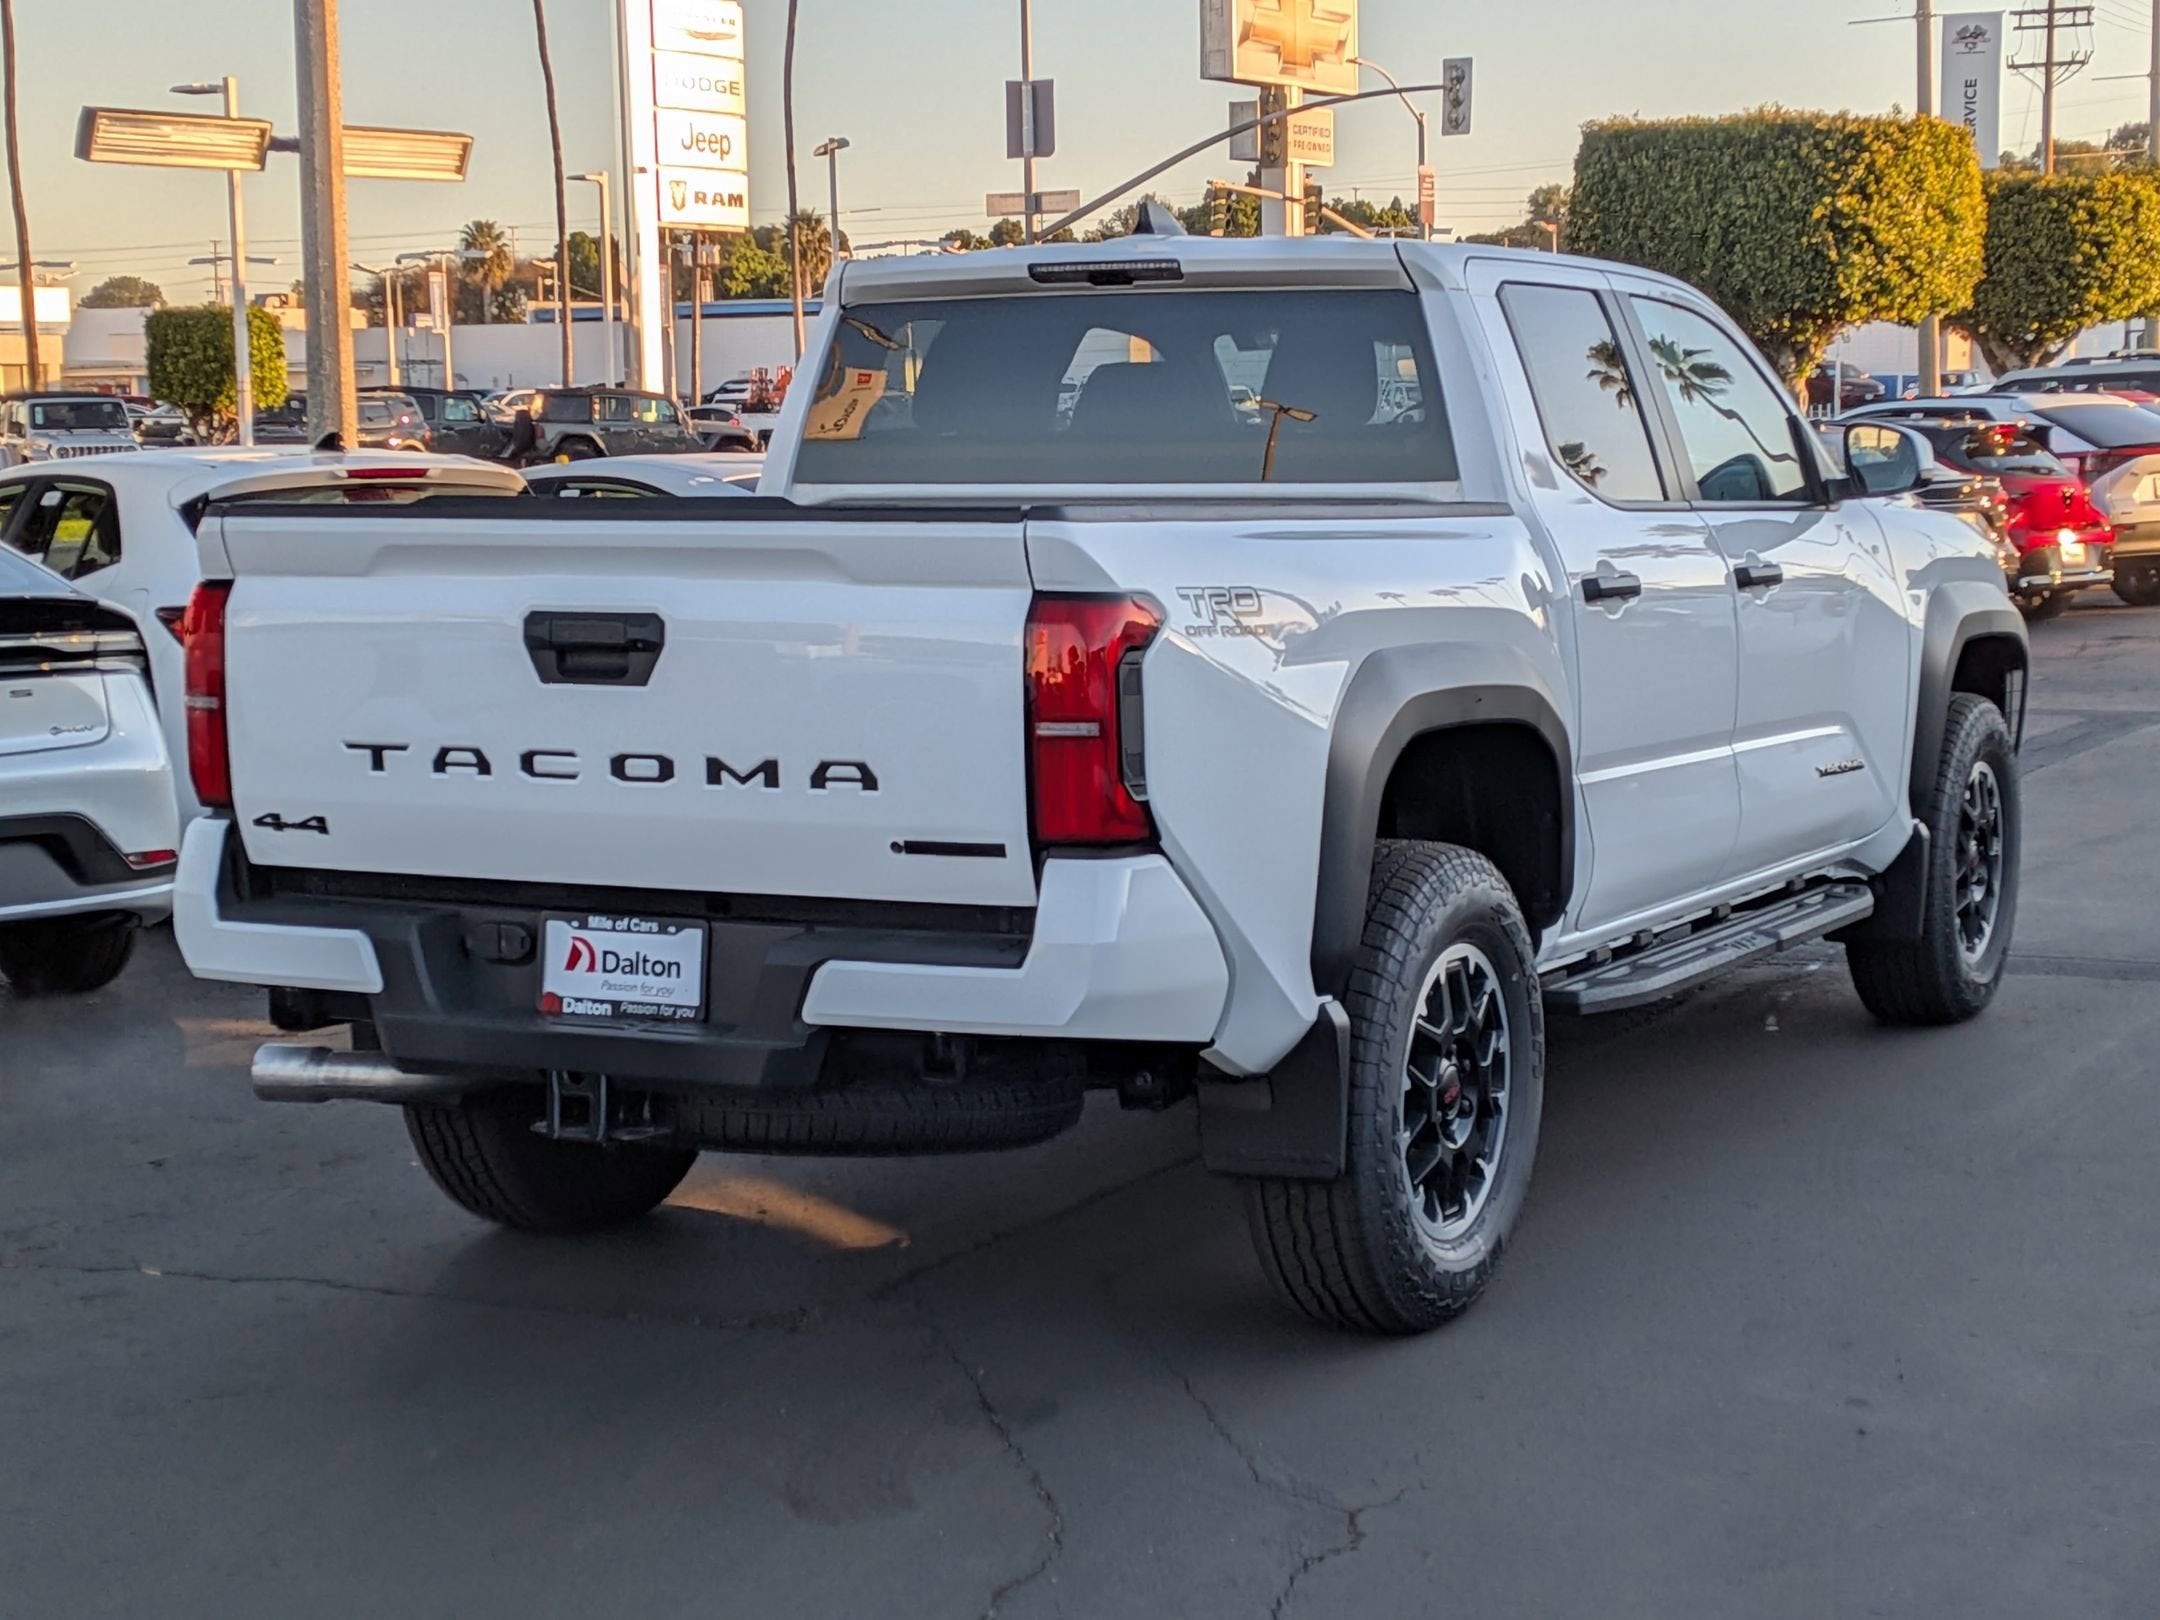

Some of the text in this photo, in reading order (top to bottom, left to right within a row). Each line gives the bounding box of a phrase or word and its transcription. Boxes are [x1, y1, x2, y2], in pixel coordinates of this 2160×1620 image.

[664, 77, 741, 96] ODGE
[1964, 78, 1977, 138] RVICE
[681, 122, 731, 161] Jeep
[694, 190, 743, 208] RAM
[1176, 586, 1263, 625] TRD
[344, 742, 879, 792] TACOMA
[587, 915, 659, 932] Mile of Cars
[602, 950, 681, 979] Dalton
[600, 980, 675, 998] Passion for you
[562, 997, 696, 1019] Dalton Passion for you
